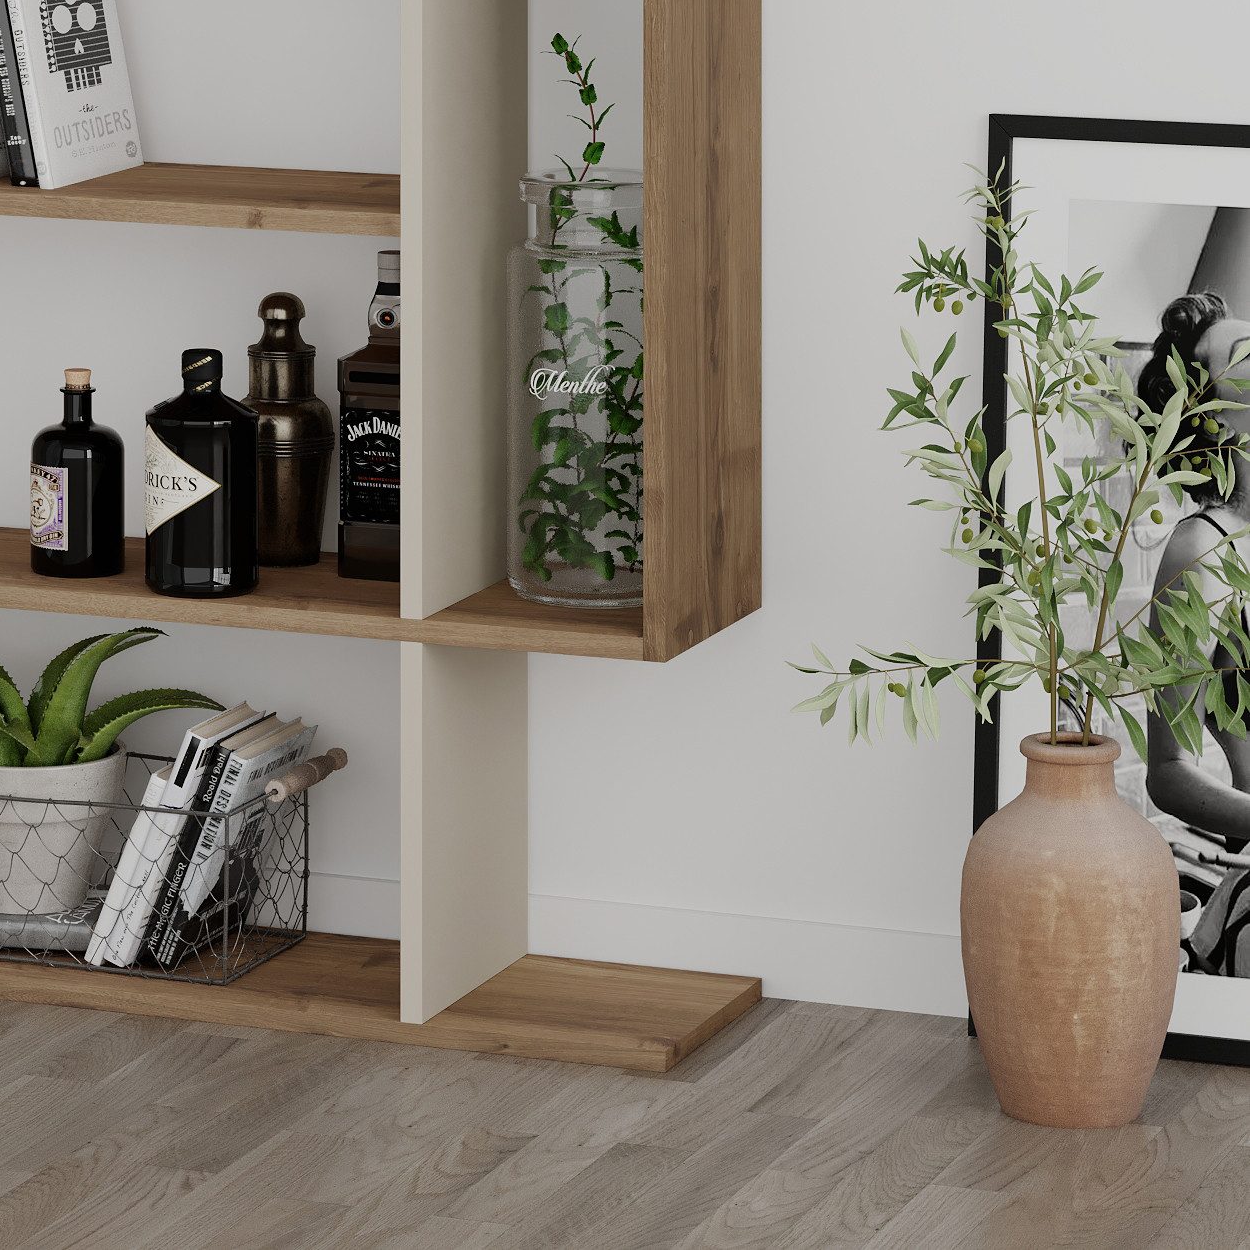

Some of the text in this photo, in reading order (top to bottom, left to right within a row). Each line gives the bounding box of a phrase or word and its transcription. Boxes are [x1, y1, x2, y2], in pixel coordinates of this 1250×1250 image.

[529, 364, 615, 401] Menthe
[346, 420, 372, 442] JACK
[203, 753, 227, 803] Roald Dahl
[223, 759, 243, 786] FINAL
